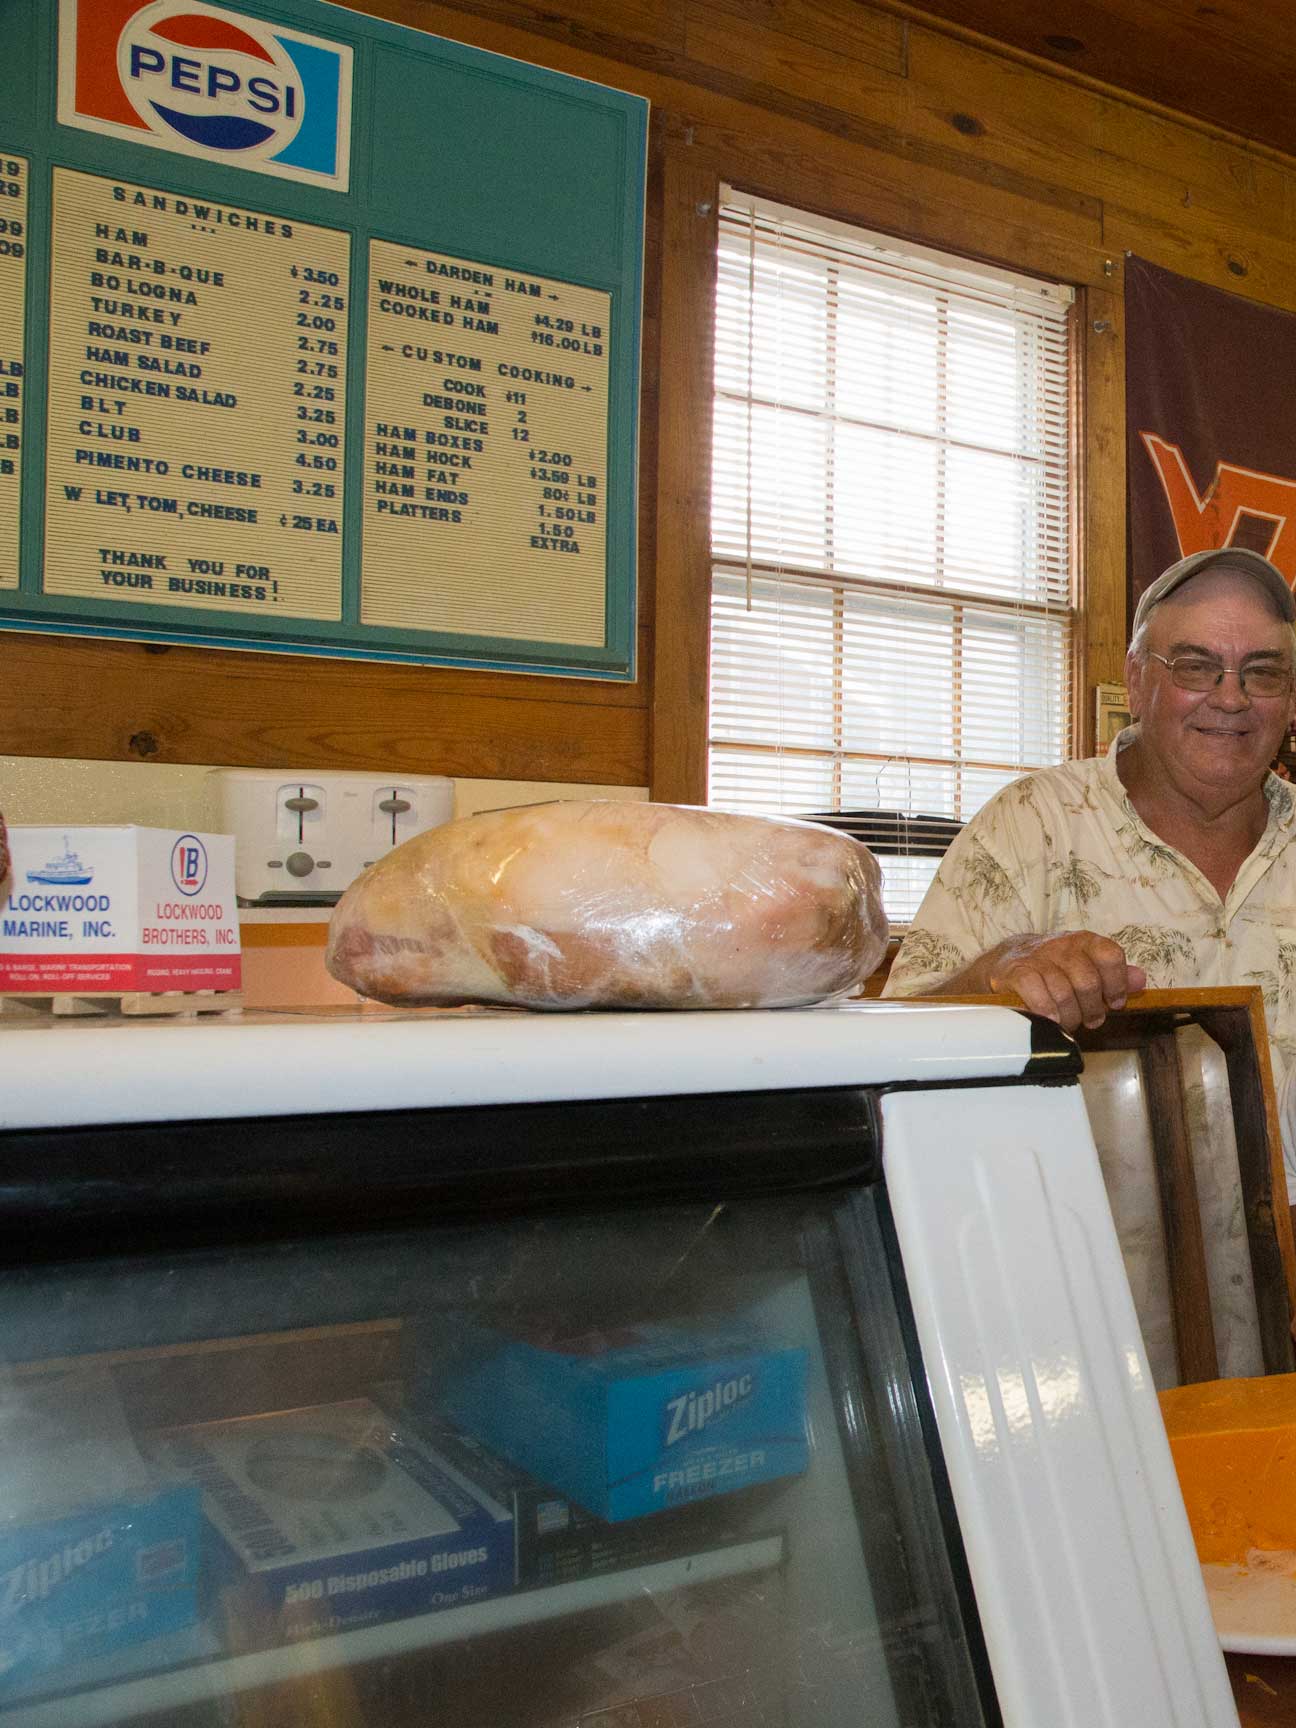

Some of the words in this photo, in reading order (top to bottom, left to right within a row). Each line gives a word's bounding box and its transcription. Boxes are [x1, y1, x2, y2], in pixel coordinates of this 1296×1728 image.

[131, 44, 295, 118] PEPSI
[112, 187, 293, 238] SANDWICHES
[95, 223, 148, 247] HAM
[299, 291, 345, 311] 2.25
[426, 260, 494, 287] DARDEN
[504, 278, 542, 298] HAM
[91, 297, 182, 327] TURKEY
[298, 337, 338, 355] 2.75
[297, 313, 335, 332] 2.00
[378, 279, 441, 305] WHOLE
[450, 296, 490, 315] HAM
[535, 314, 574, 334] $4.29
[582, 322, 602, 339] LB
[380, 299, 454, 325] COOKED
[463, 316, 499, 335] HAM
[583, 342, 603, 357] LB
[89, 321, 153, 346] ROAST
[161, 335, 211, 355] BEEF
[297, 359, 338, 379] 2.75
[402, 344, 481, 371] CUSTOM
[498, 363, 575, 389] COOKING
[86, 346, 130, 367] HAM
[137, 354, 202, 379] SALAD
[294, 382, 335, 401] 2.25
[443, 379, 486, 398] COOK
[80, 370, 171, 398] CHICKEN
[175, 386, 238, 408] SALAD
[297, 406, 336, 424] 3.25
[423, 393, 487, 416] DEBONE
[518, 410, 527, 424] 2
[81, 395, 127, 415] BLT
[297, 429, 339, 448] 3.00
[444, 415, 489, 435] SLICE
[512, 427, 529, 442] 12
[79, 420, 141, 442] CLUB
[296, 453, 338, 471] 4.50
[375, 442, 416, 460] HAM
[427, 450, 472, 469] HOCK
[530, 467, 570, 484] $3.59
[578, 474, 597, 489] LB
[376, 423, 417, 441] HAM
[426, 431, 483, 453] BOXES
[529, 449, 572, 467] $2.00
[76, 449, 169, 475] PIMENTO
[182, 465, 262, 488] CHEESE
[293, 480, 335, 498] 3.25
[375, 461, 415, 479] HAM
[427, 469, 459, 485] FAT
[578, 491, 597, 506] LB
[64, 486, 82, 501] W
[187, 501, 258, 524] CHEESE
[316, 518, 339, 534] EA
[375, 480, 415, 498] HAM
[425, 487, 469, 506] ENDS
[538, 504, 576, 521] 1.50
[577, 509, 596, 524] LB
[377, 499, 462, 523] PLATTERS
[539, 522, 574, 538] 1.50
[99, 549, 167, 570] THANK
[188, 558, 224, 576] YOU
[236, 564, 270, 581] FOR
[530, 535, 580, 554] EXTRA
[100, 570, 154, 590] YOUR
[8, 894, 110, 912] LOCKWOOD
[156, 903, 223, 920] LOCKWOOD
[3, 920, 74, 941] MARINE,
[83, 920, 116, 938] INC.
[142, 928, 210, 947] BROTHERS,
[215, 928, 238, 945] INC.
[666, 1373, 753, 1447] Ziploc
[653, 1449, 766, 1493] FREEZER
[327, 1557, 427, 1595] Disposable
[431, 1546, 488, 1572] Gloves
